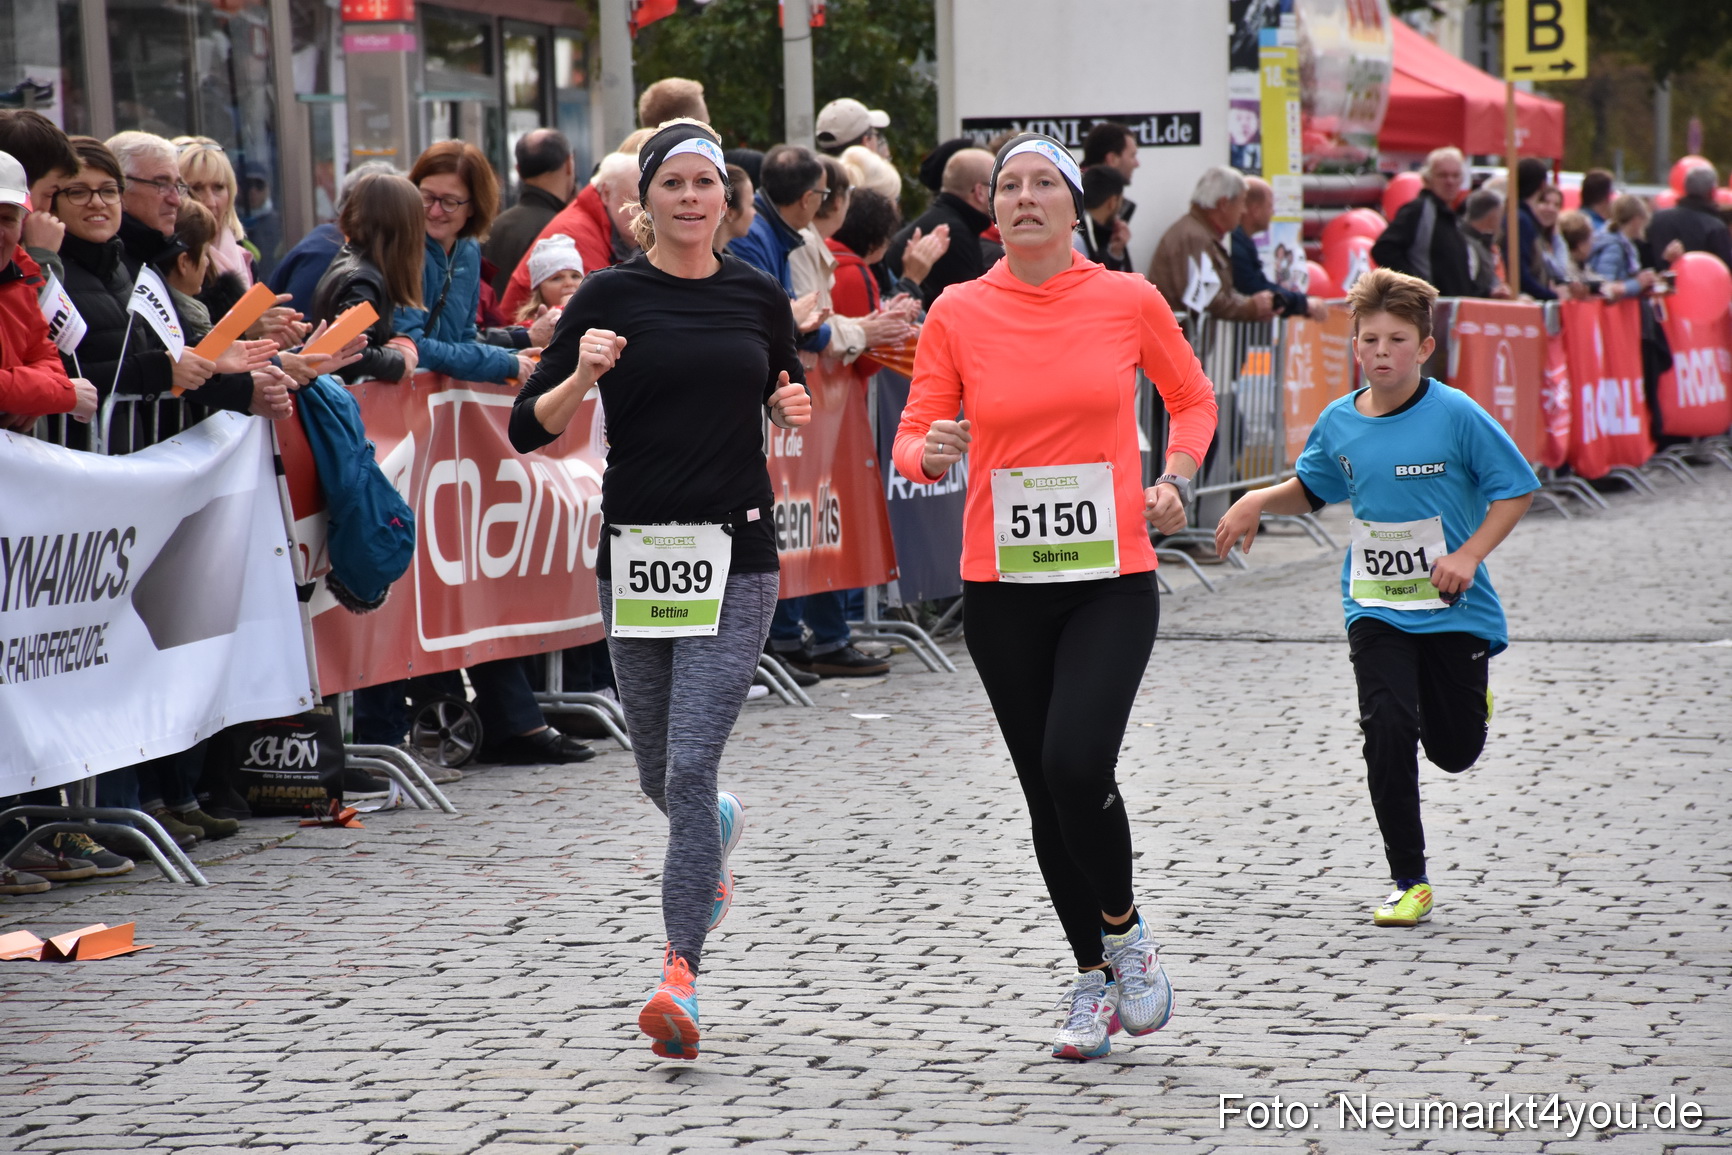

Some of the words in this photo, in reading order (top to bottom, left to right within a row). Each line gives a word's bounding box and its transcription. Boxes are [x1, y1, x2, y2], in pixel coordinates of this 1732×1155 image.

[1526, 0, 1564, 53] B
[134, 284, 170, 323] swn
[47, 309, 69, 341] wn
[1036, 476, 1078, 487] BOCK
[1395, 463, 1445, 475] BOCK
[1011, 500, 1097, 539] 5150
[654, 536, 696, 545] BOCK
[1379, 530, 1412, 539] BOCK
[1033, 550, 1079, 563] Sabrina
[1364, 547, 1429, 576] 5201
[629, 560, 713, 594] 5039
[1385, 584, 1418, 595] Pascal
[651, 606, 689, 618] Bettina
[7, 622, 110, 684] FAHRFREUDE.
[244, 730, 319, 769] SCHÖN
